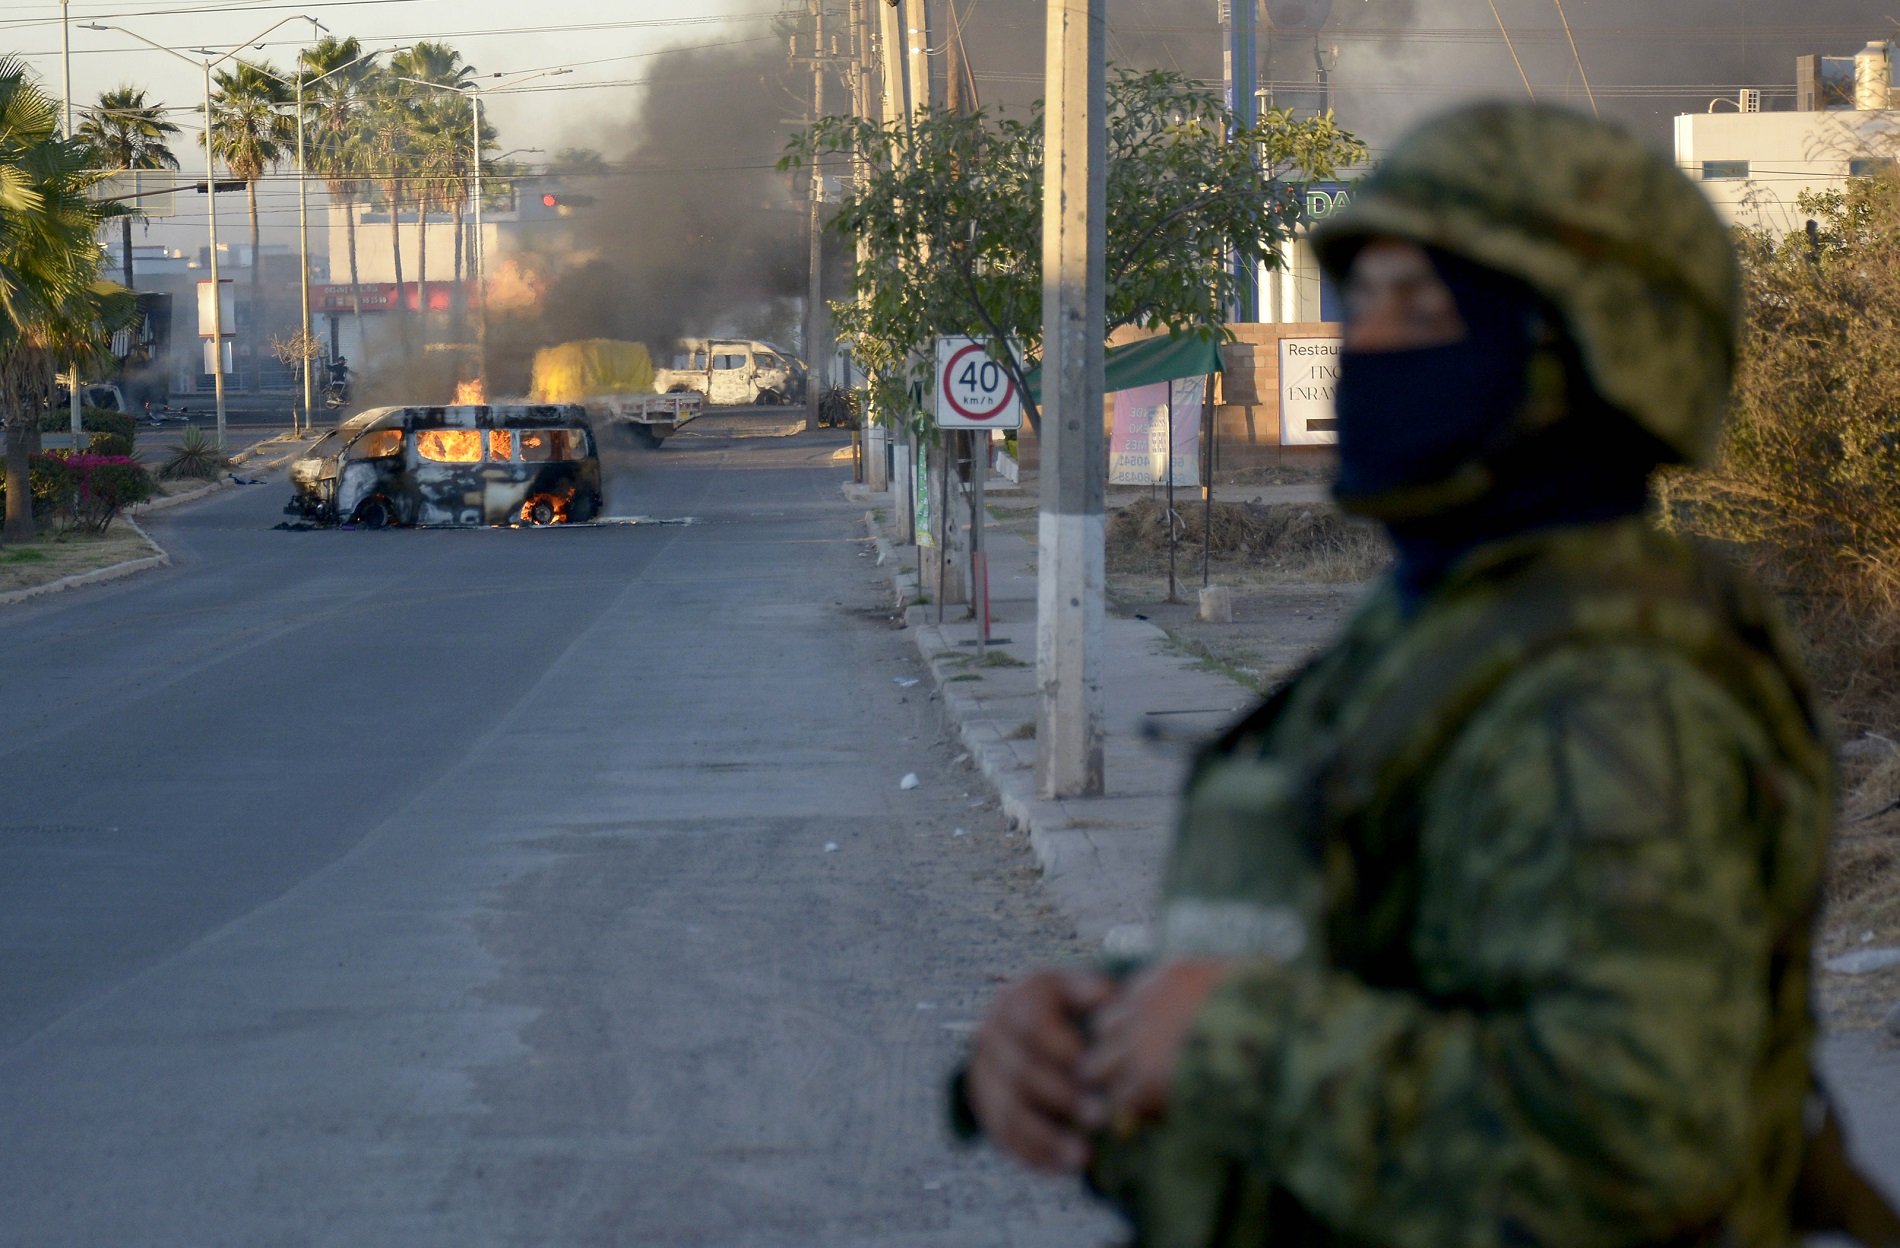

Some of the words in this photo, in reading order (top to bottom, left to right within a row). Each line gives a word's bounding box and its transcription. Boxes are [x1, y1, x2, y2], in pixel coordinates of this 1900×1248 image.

[1306, 190, 1356, 219] DA
[958, 360, 999, 393] 40
[963, 396, 994, 405] km/h
